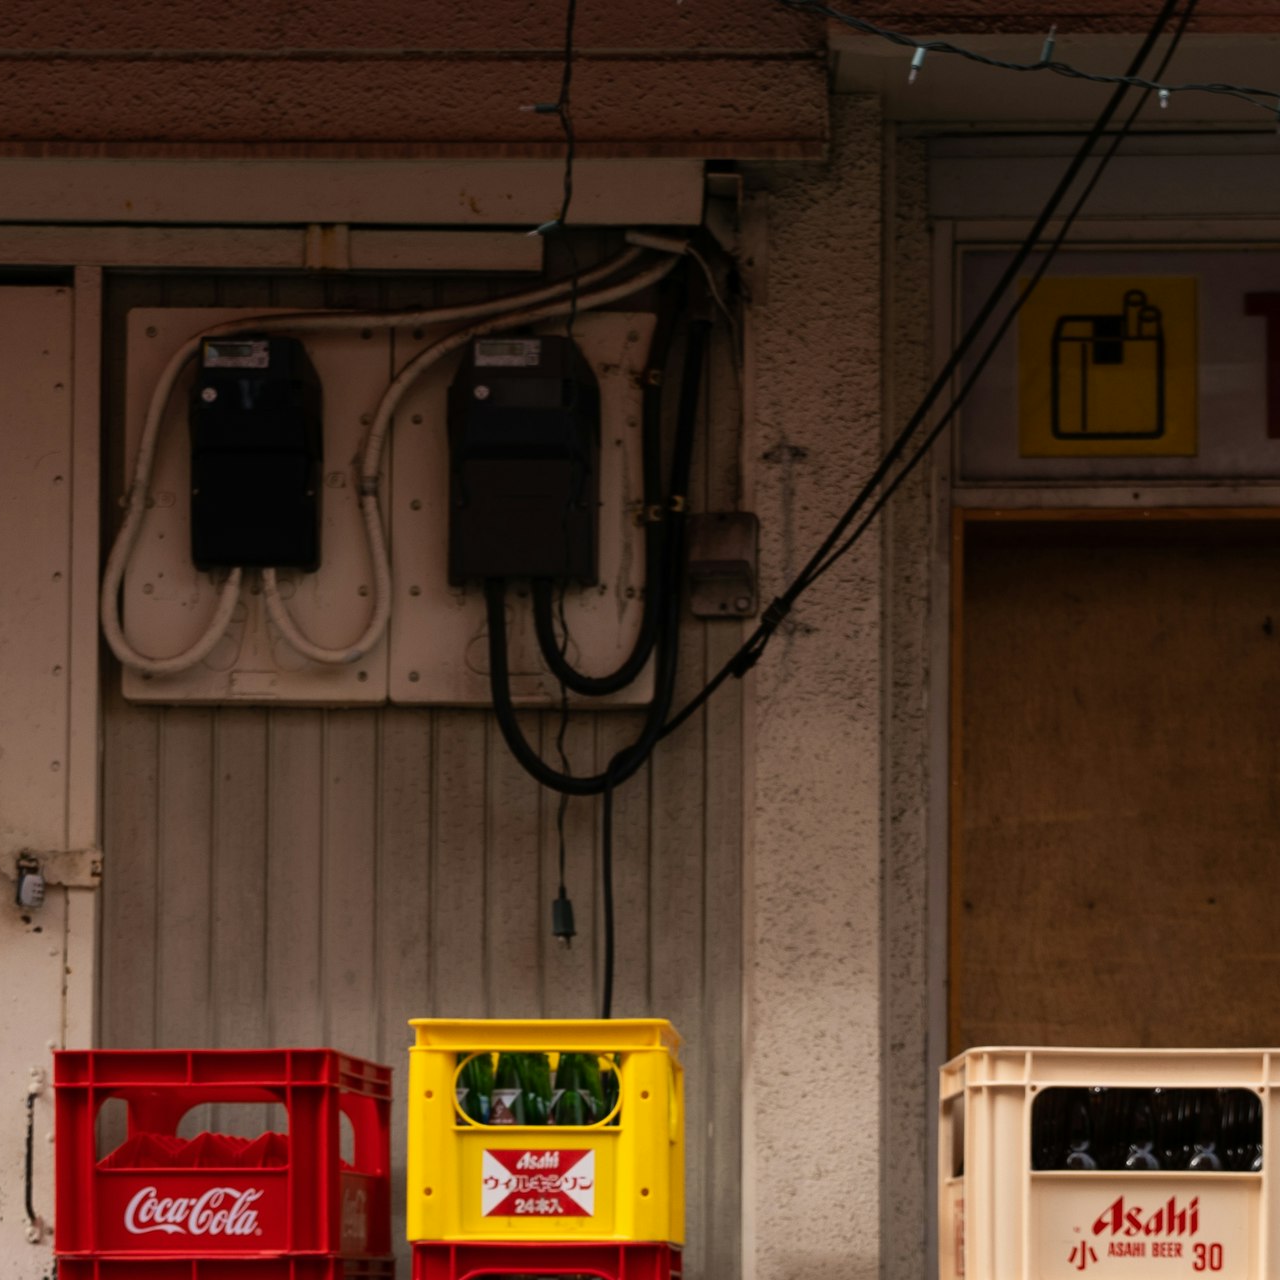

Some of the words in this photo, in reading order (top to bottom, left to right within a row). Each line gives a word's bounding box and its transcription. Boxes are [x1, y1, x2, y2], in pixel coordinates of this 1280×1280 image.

[515, 1151, 560, 1170] Asahi
[482, 1174, 594, 1194] ウィルキンソン
[124, 1186, 265, 1236] Coca-Cola
[514, 1197, 563, 1215] 24本入
[1091, 1195, 1200, 1236] Asahi
[1068, 1240, 1099, 1271] 小
[1107, 1242, 1147, 1258] ASAHI
[1152, 1242, 1183, 1258] BEER
[1192, 1243, 1223, 1272] 30
